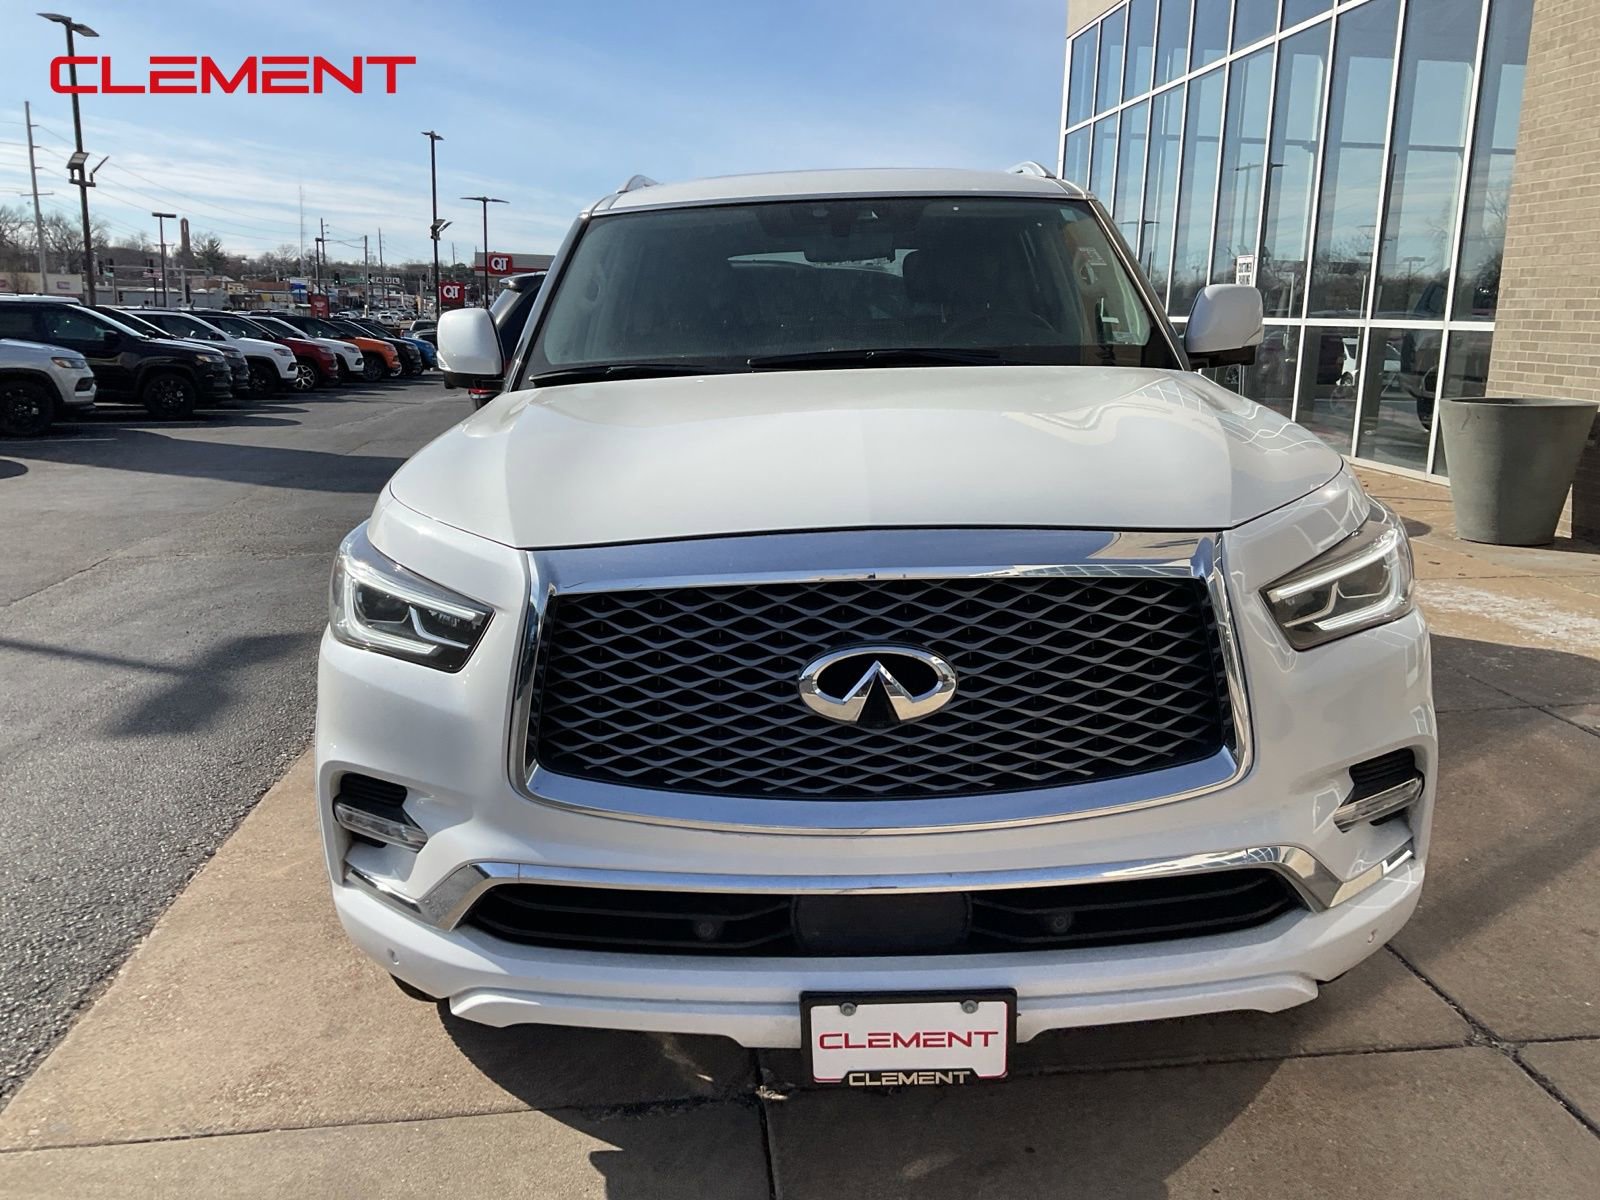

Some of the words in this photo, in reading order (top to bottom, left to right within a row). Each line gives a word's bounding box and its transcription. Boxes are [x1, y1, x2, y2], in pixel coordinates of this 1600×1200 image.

[491, 257, 508, 271] QT
[443, 285, 460, 299] QT
[819, 1031, 999, 1050] CLEMENT
[848, 1071, 971, 1087] CLEMENT
